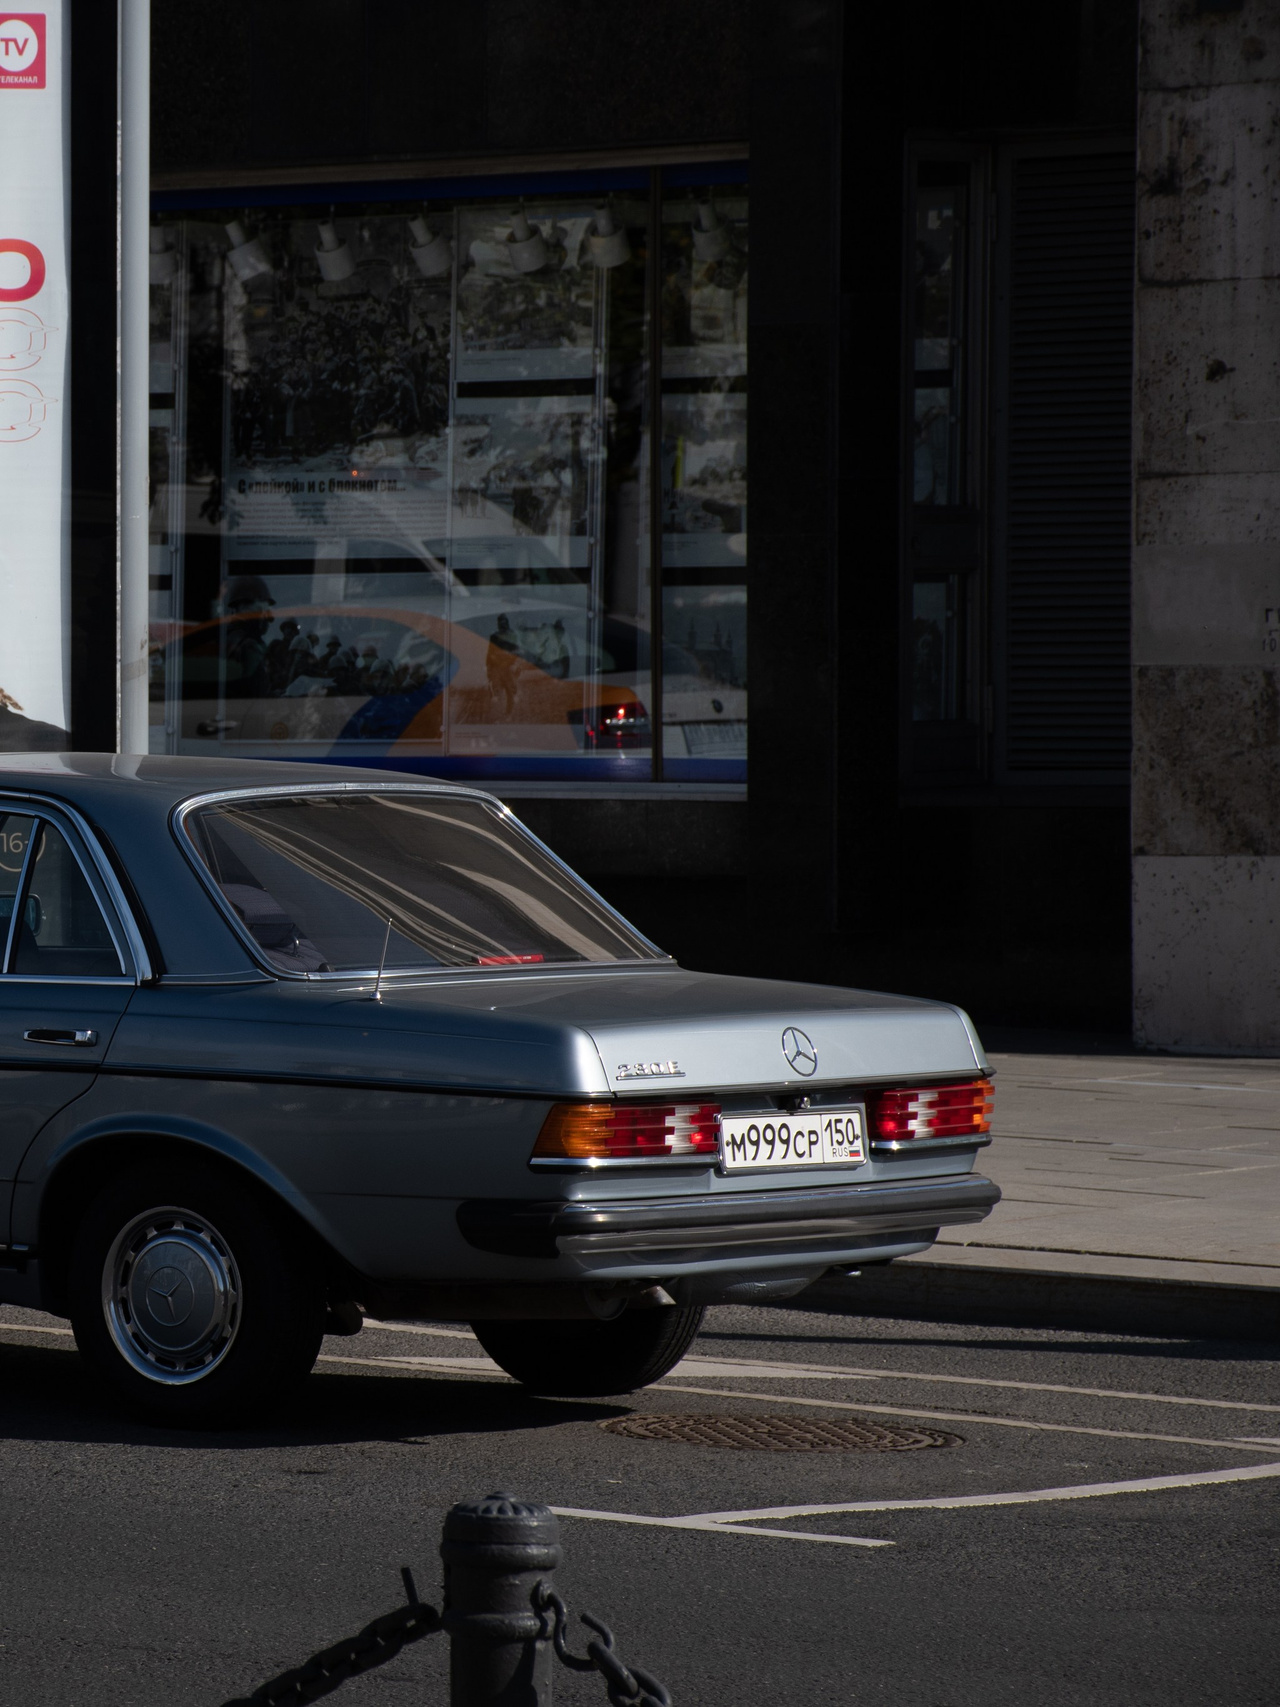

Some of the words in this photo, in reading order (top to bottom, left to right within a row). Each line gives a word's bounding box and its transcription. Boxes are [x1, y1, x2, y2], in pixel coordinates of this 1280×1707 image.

[0, 37, 29, 56] TV
[237, 479, 246, 494] С
[307, 480, 316, 493] и
[318, 480, 326, 493] с
[617, 1061, 681, 1077] 230E
[824, 1118, 856, 1147] 150
[832, 1147, 849, 1158] RUS
